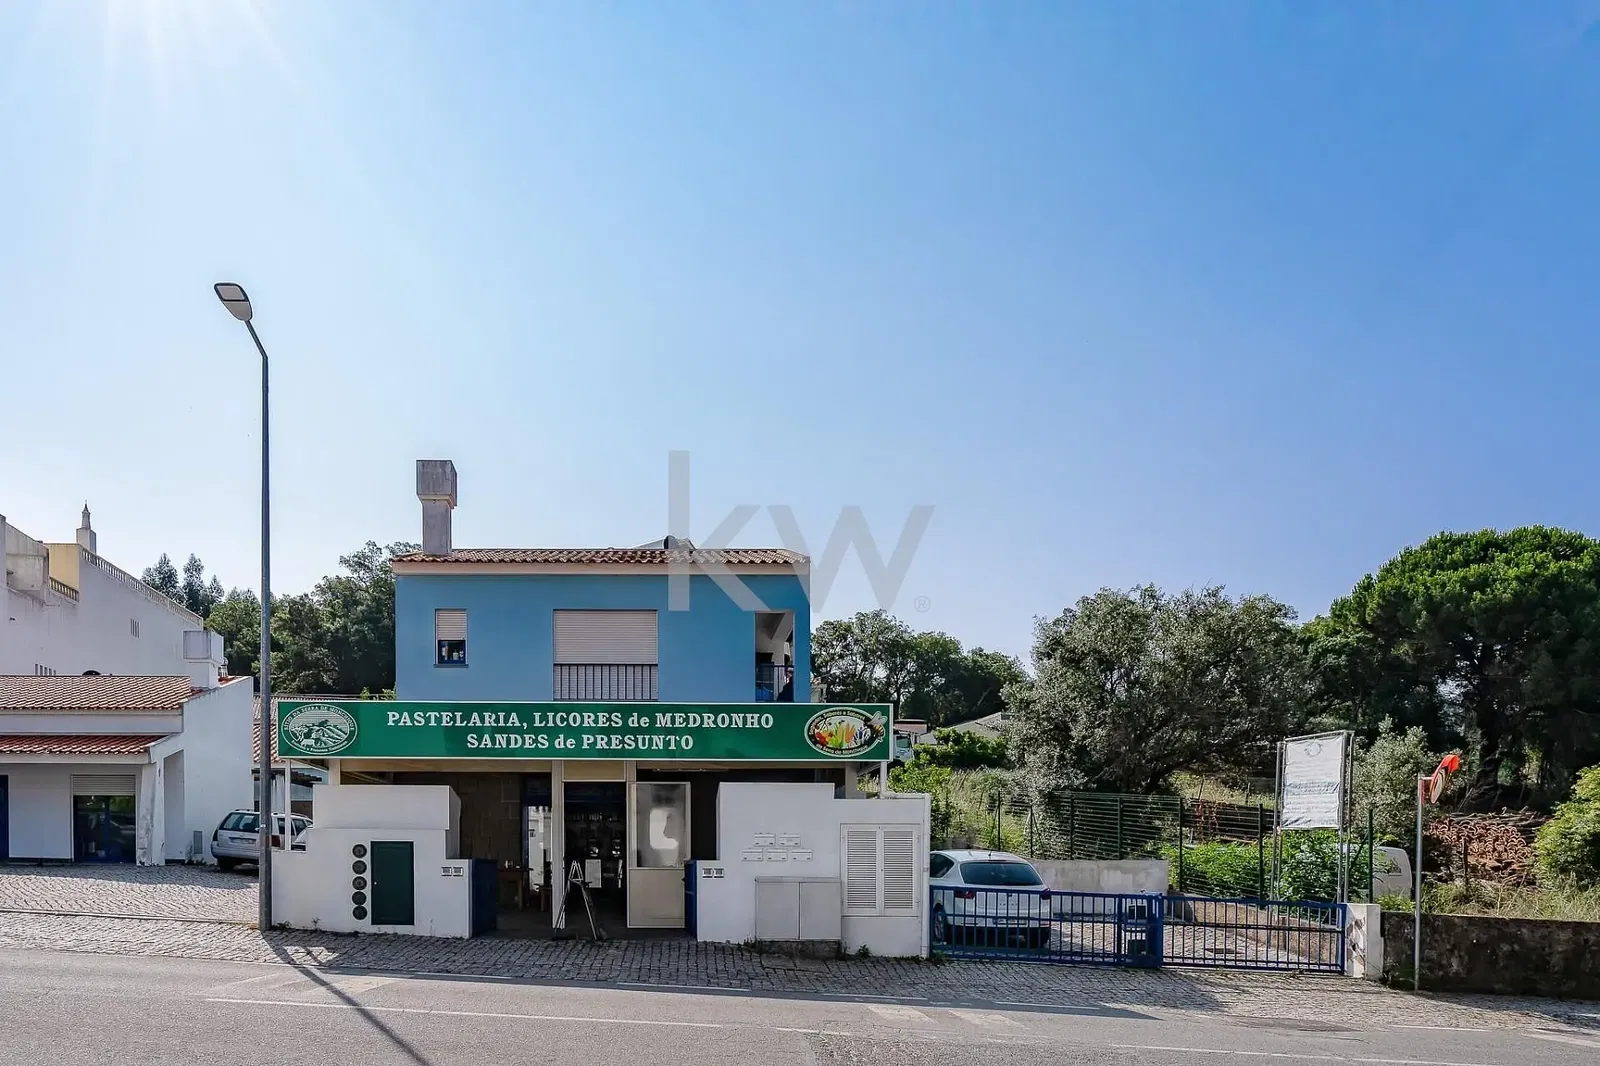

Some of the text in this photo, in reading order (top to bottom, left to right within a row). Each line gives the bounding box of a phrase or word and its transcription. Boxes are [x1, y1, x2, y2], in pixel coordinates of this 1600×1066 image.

[387, 711, 774, 729] PASTELARIA, LICORES de MEDRONHO
[467, 733, 693, 749] SANDES de PRESUNTO
